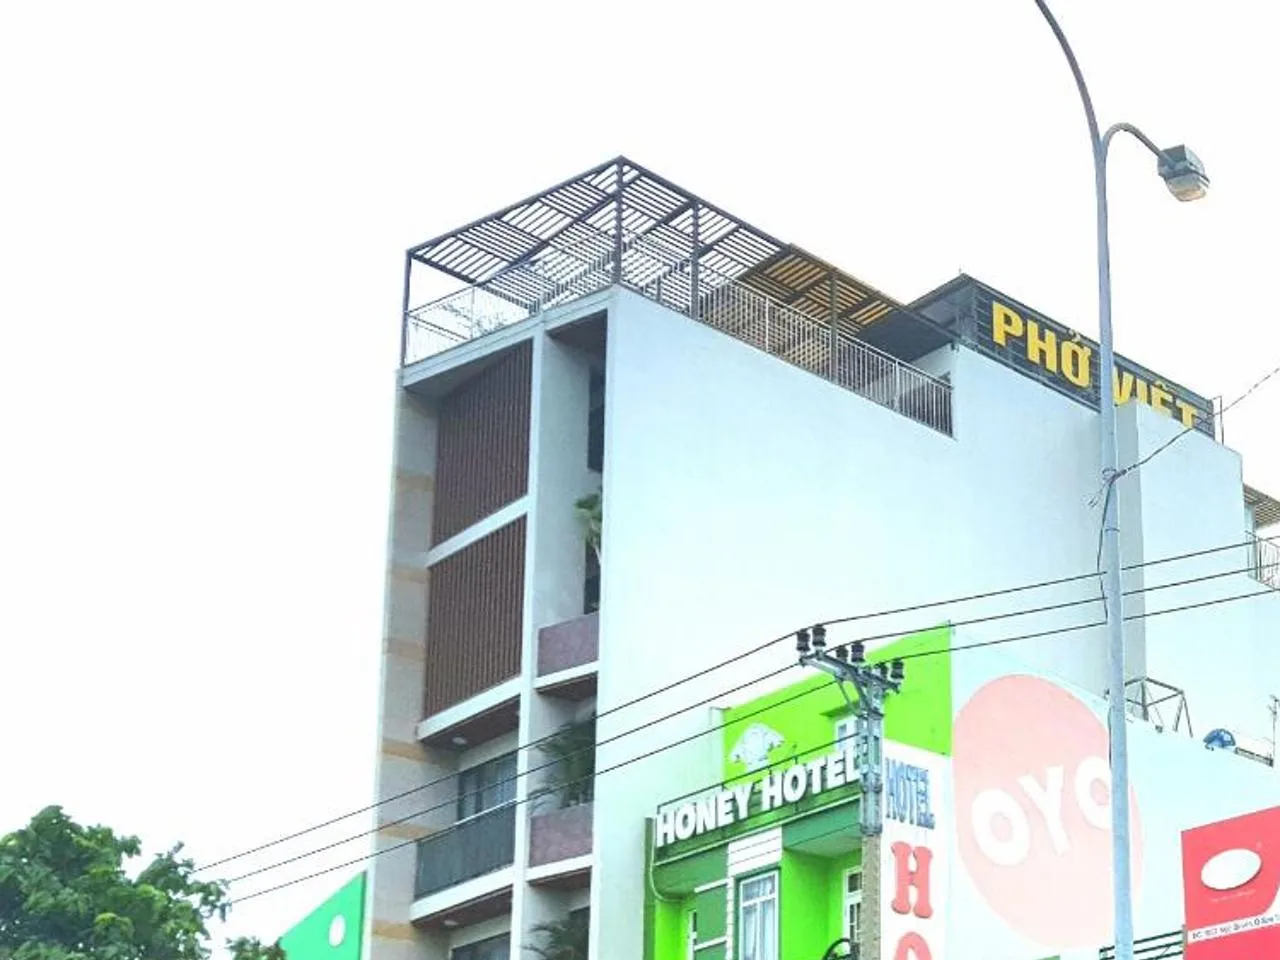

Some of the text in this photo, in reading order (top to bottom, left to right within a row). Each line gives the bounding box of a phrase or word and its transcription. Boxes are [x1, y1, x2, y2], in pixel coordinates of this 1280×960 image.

[992, 301, 1092, 389] PHỞ
[656, 746, 861, 848] HONEY HOTEL
[971, 755, 1112, 867] OYO
